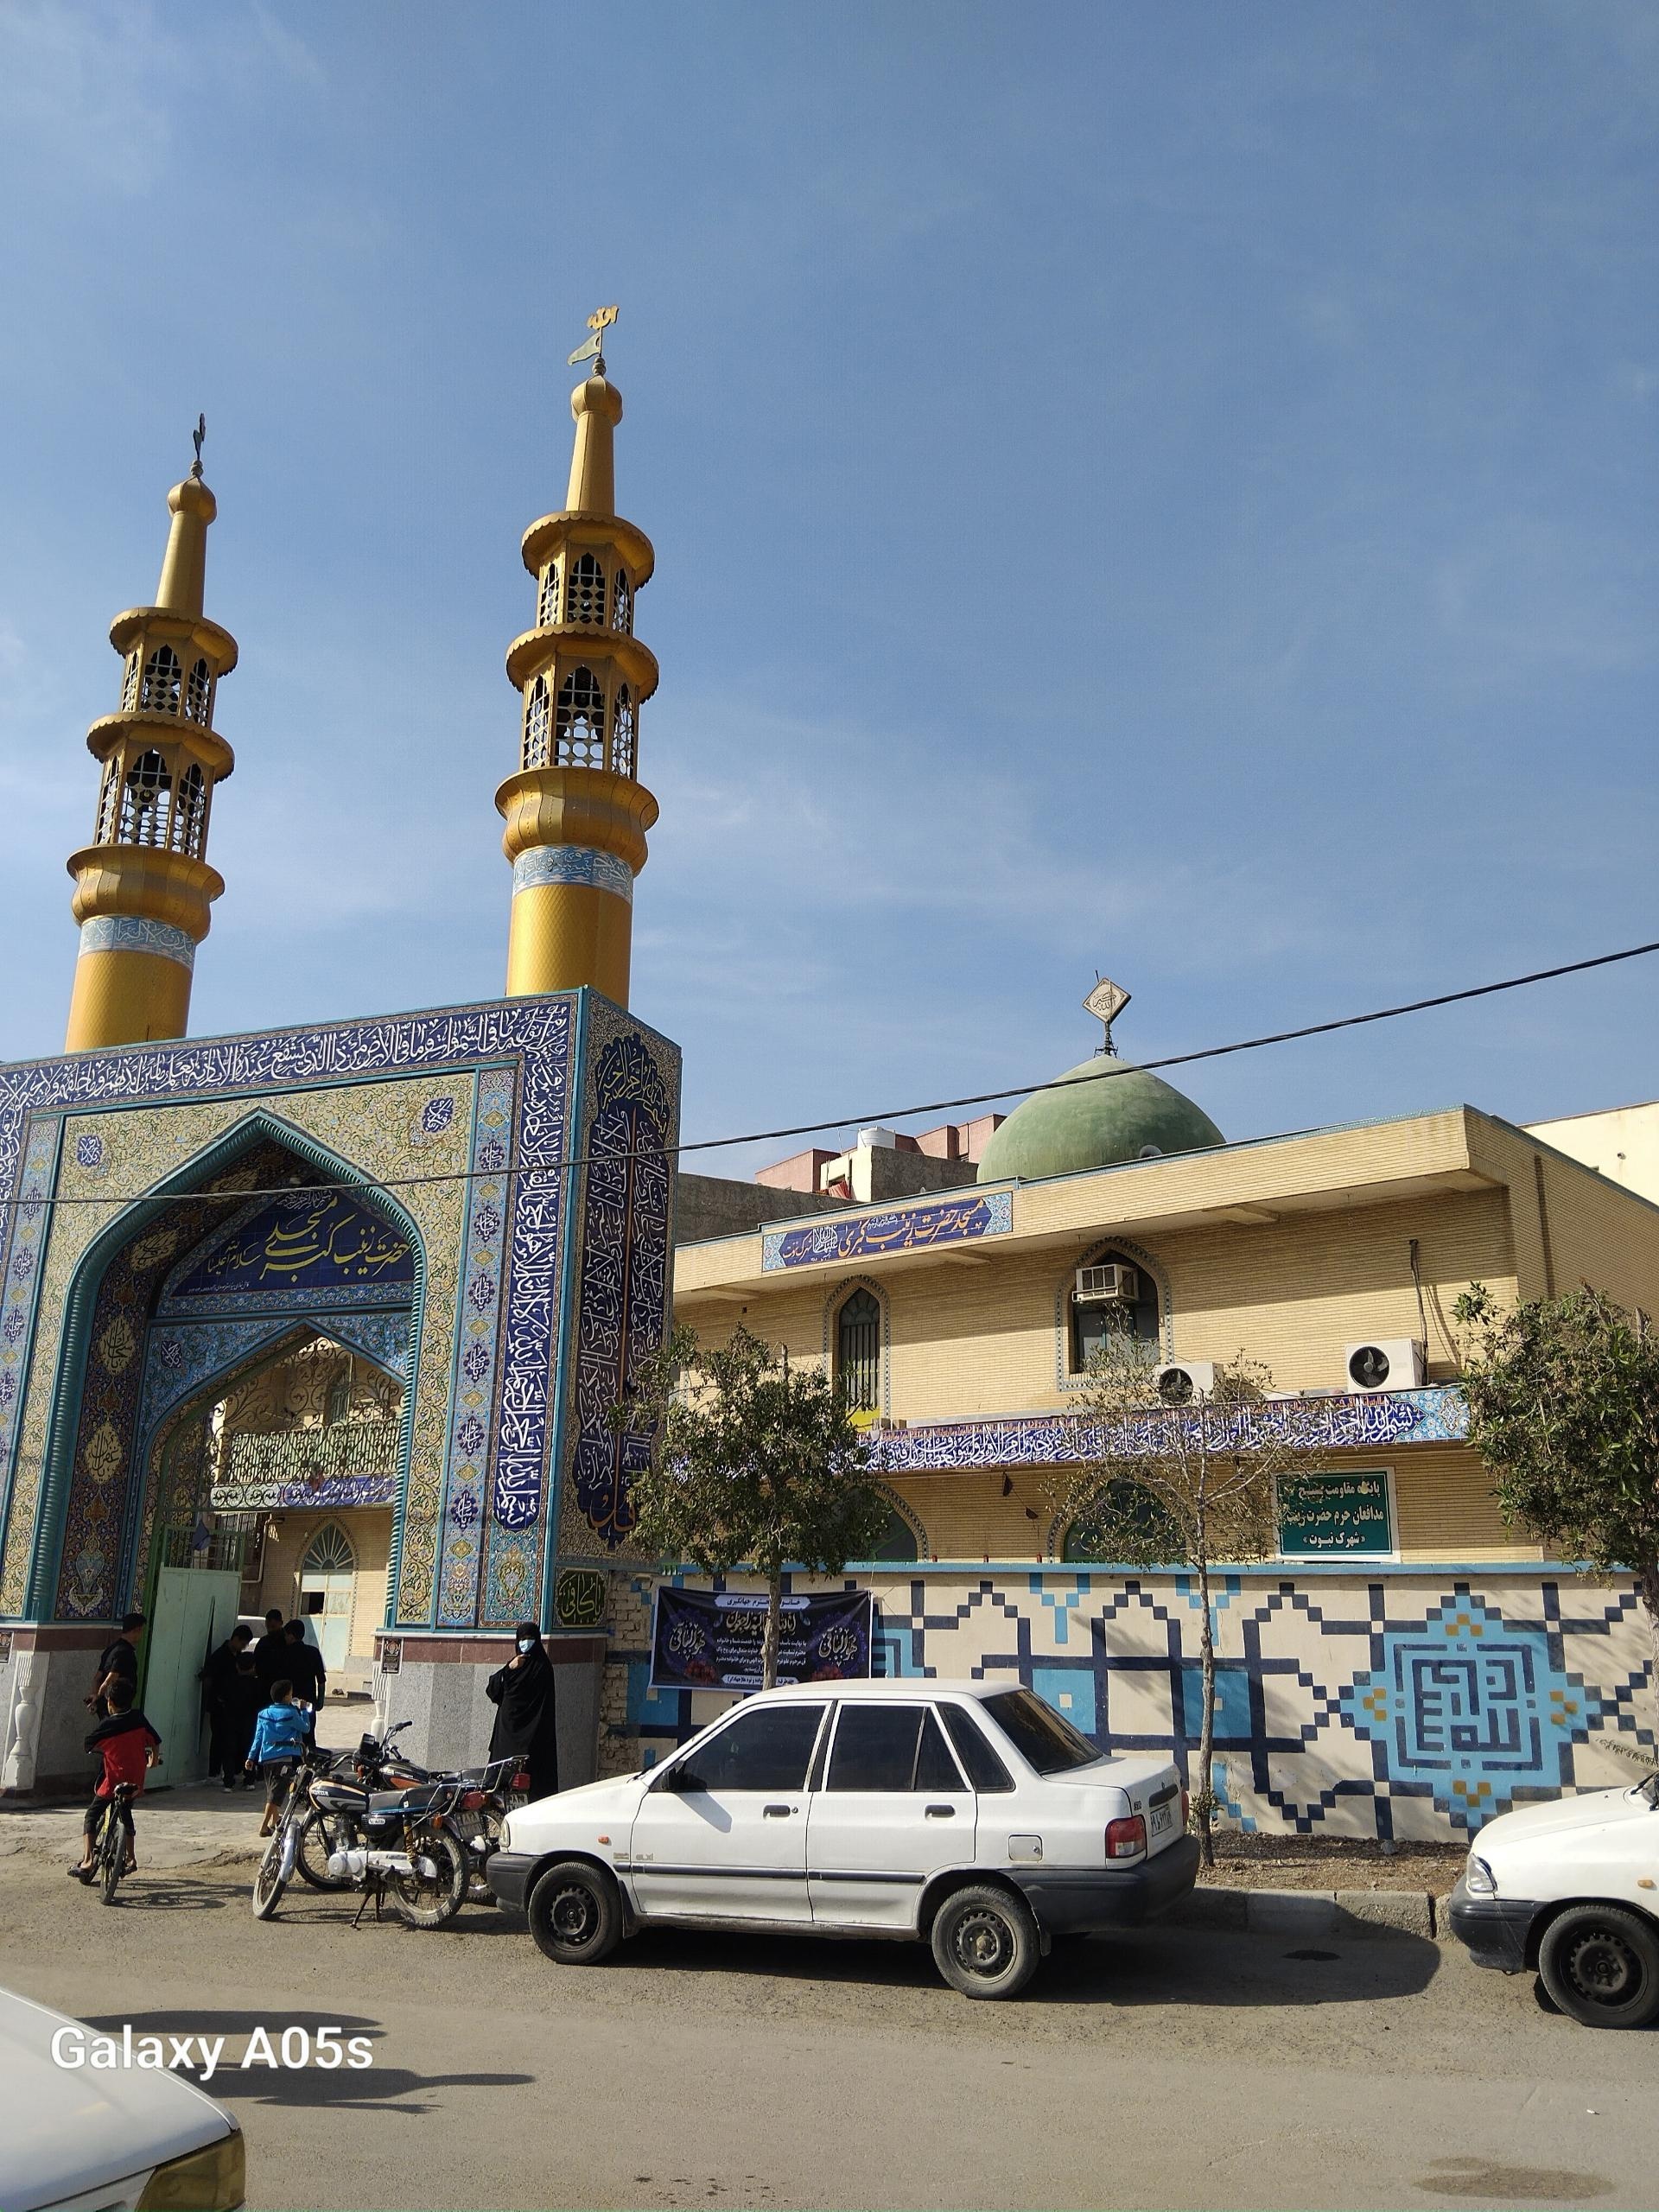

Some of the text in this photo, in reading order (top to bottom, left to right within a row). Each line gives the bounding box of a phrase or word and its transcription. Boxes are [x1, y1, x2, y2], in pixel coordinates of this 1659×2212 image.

[265, 1196, 339, 1242] مسجد
[866, 1212, 917, 1250] زینب
[915, 1209, 957, 1244] حضرت
[951, 1198, 985, 1237] مسجد
[334, 1226, 375, 1276] زینب
[365, 1232, 411, 1277] حضرت
[838, 1220, 867, 1257] کبری
[1325, 1481, 1356, 1499] مقاومت
[1357, 1480, 1381, 1498] پایه
[1306, 1507, 1332, 1527] حضرت
[1333, 1510, 1351, 1527] حرم
[1352, 1504, 1384, 1526] مدافعان
